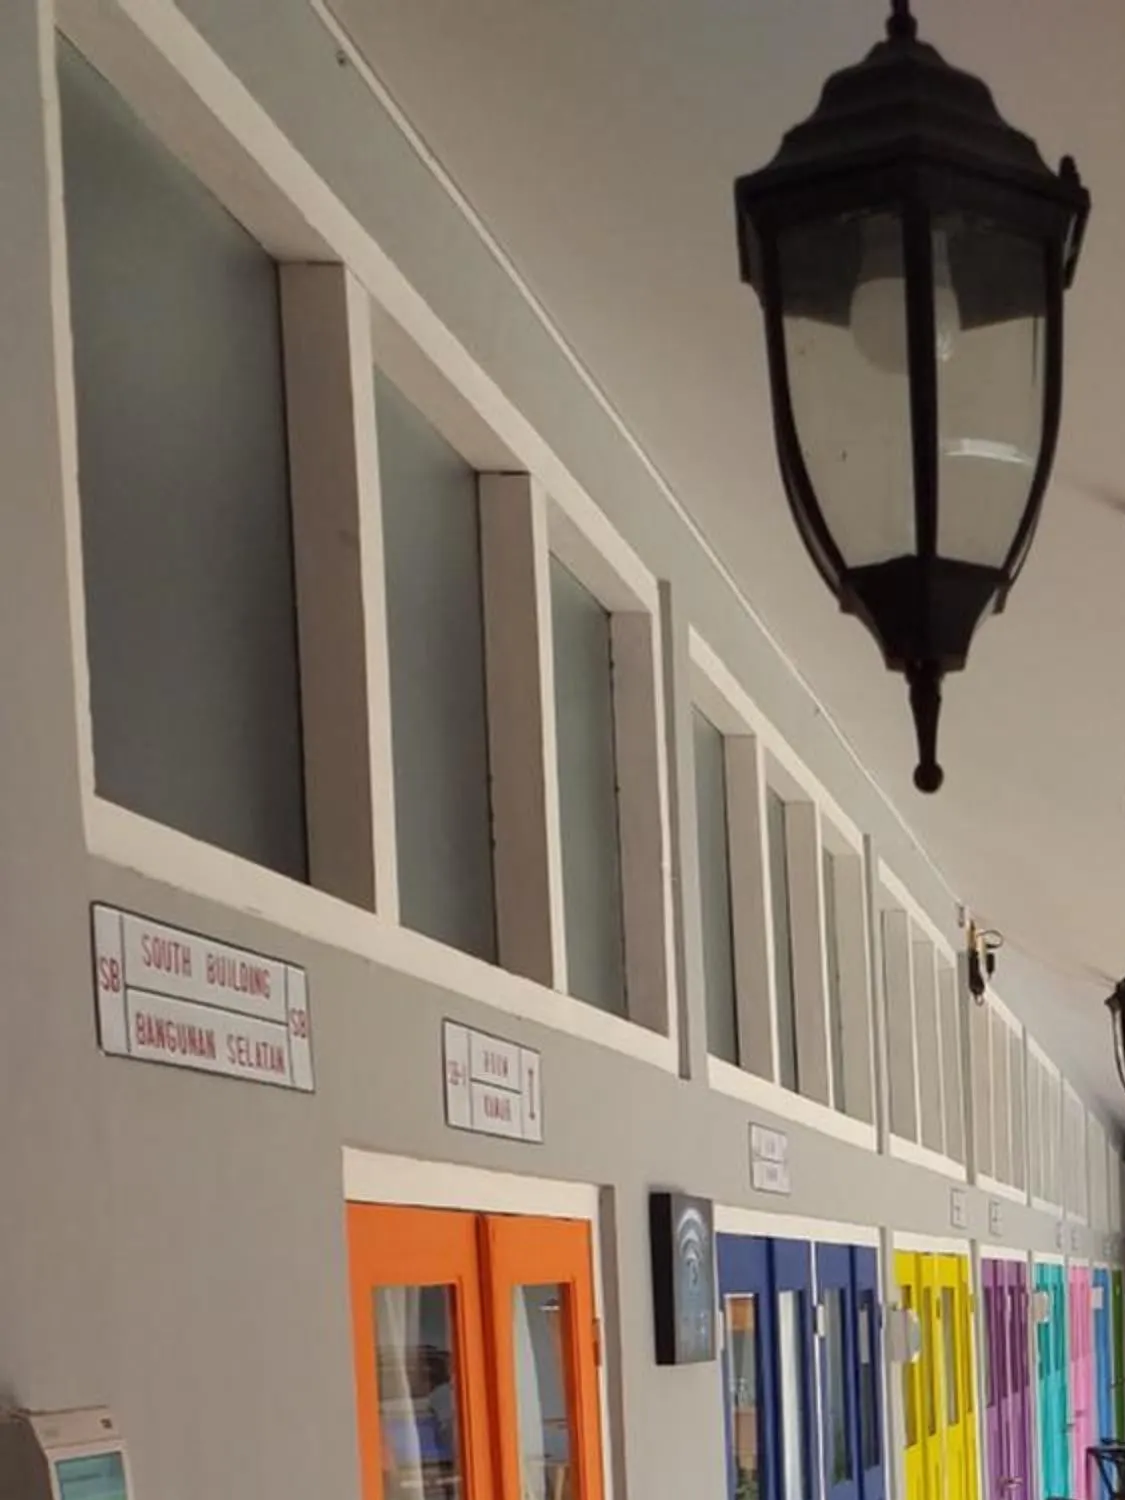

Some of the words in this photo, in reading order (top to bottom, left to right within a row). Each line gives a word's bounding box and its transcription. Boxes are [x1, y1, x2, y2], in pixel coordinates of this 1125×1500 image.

[100, 956, 120, 993] SB
[141, 934, 192, 977] SOUTH
[206, 953, 271, 999] BUILDING
[135, 1011, 216, 1060] BANGUNAN
[226, 1034, 285, 1075] SELATAN
[290, 1007, 308, 1039] SB
